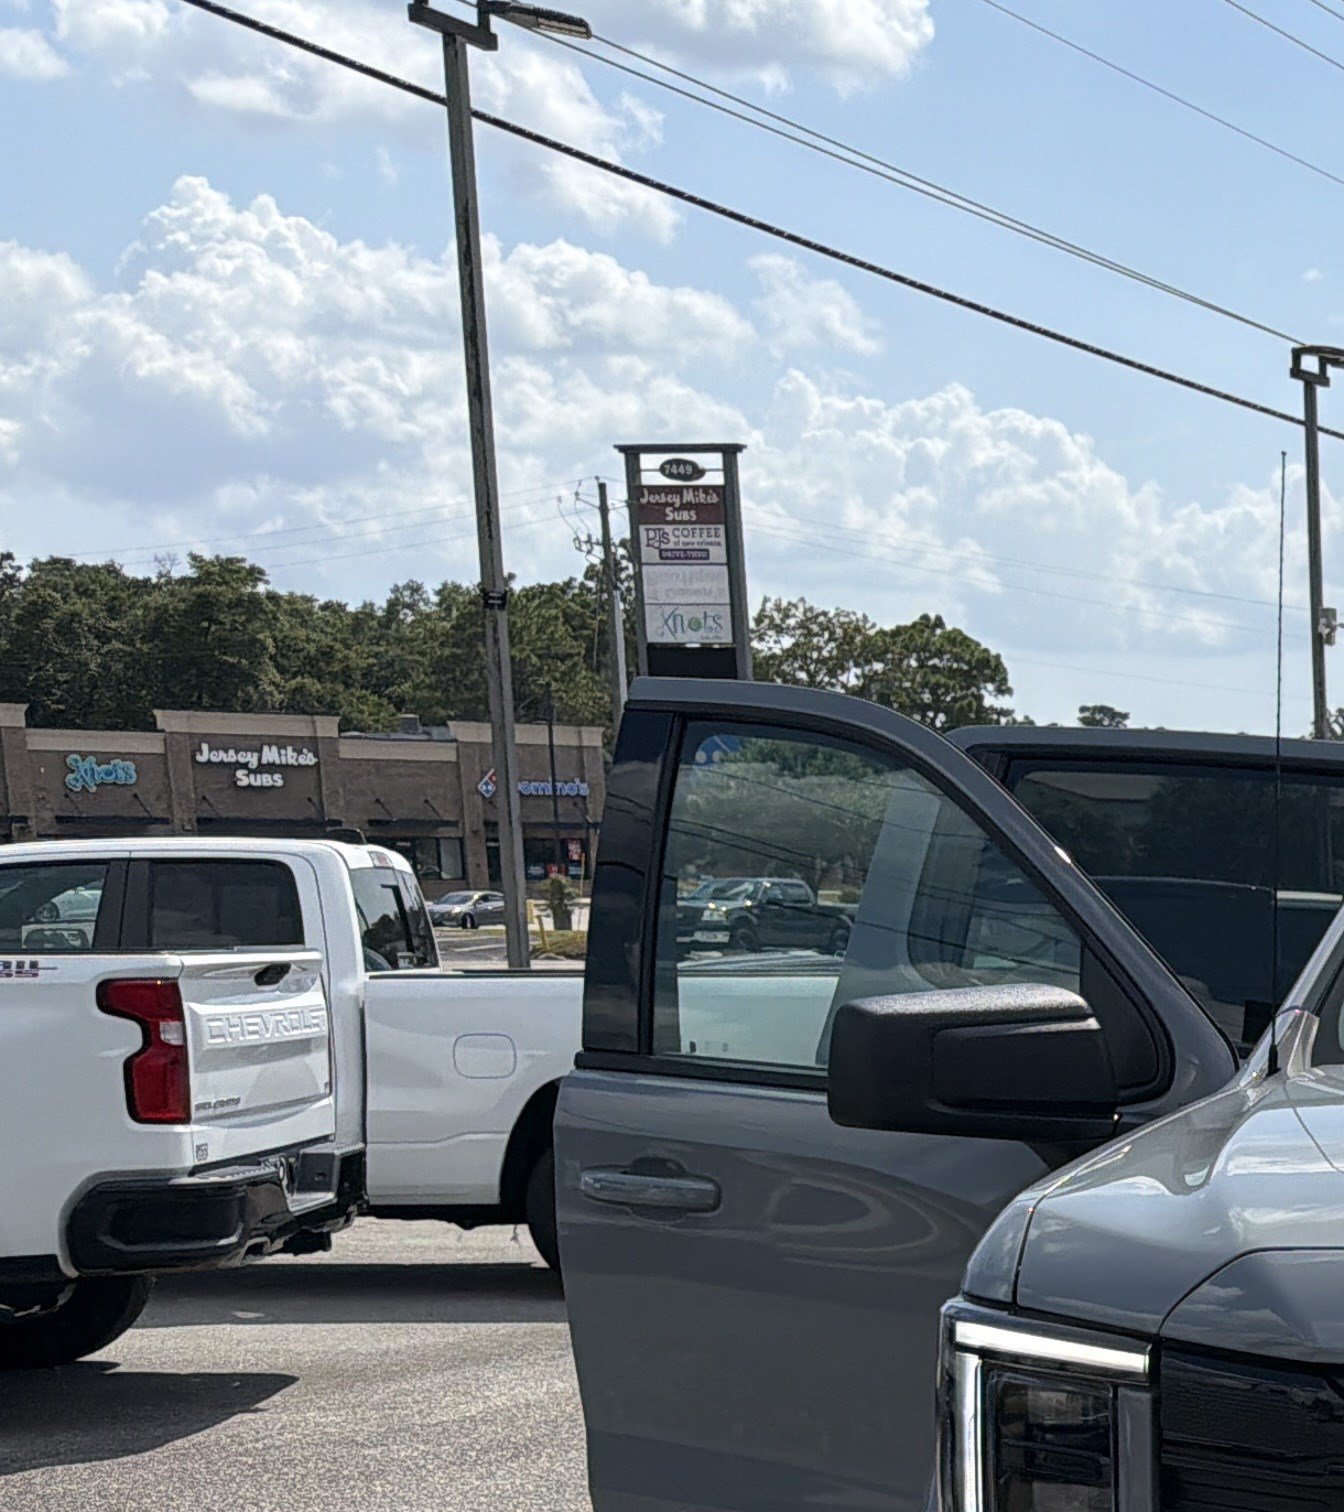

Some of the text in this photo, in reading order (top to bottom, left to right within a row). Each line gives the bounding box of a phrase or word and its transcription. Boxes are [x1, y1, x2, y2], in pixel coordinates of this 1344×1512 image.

[663, 464, 693, 475] 7449
[640, 488, 720, 508] Jersey Mike's
[672, 527, 721, 539] COFFEE
[196, 743, 319, 769] Jersey Mike's
[518, 776, 590, 797] omino's
